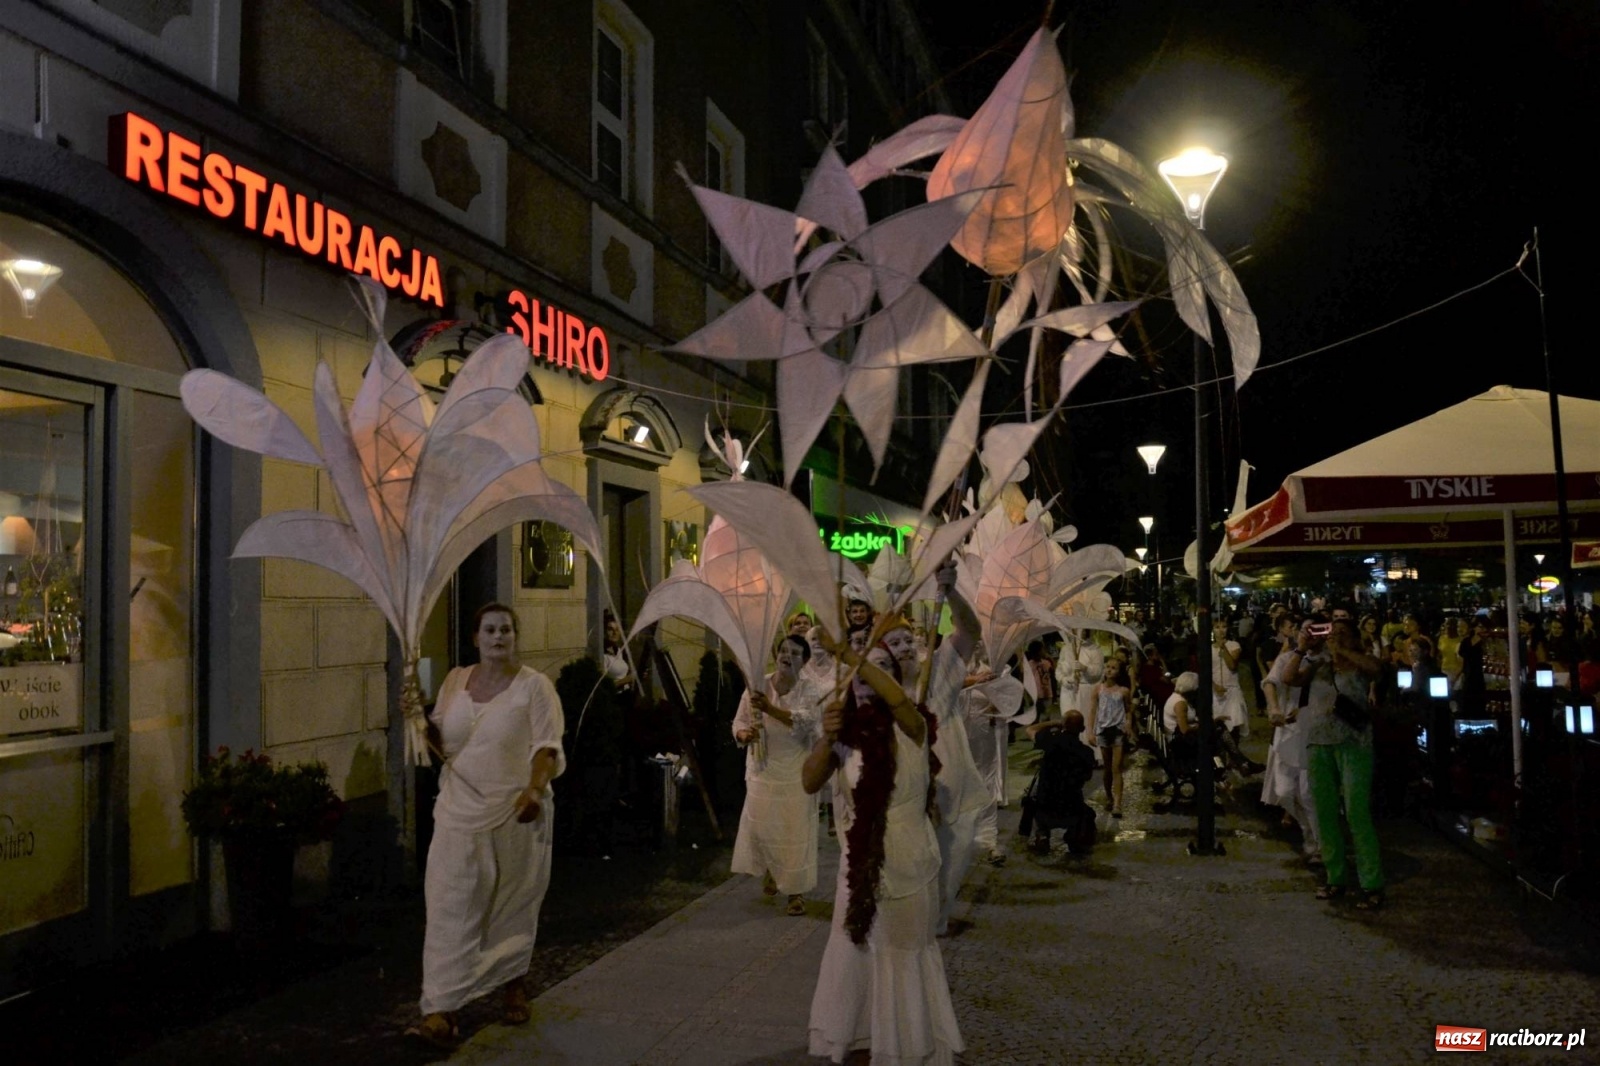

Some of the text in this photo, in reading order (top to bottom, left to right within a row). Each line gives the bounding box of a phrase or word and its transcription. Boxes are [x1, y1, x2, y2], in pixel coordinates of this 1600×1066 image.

[122, 111, 446, 308] RESTAURACJA
[506, 290, 610, 382] SHIRO
[1404, 476, 1497, 500] TYSKIE
[18, 701, 60, 721] obok
